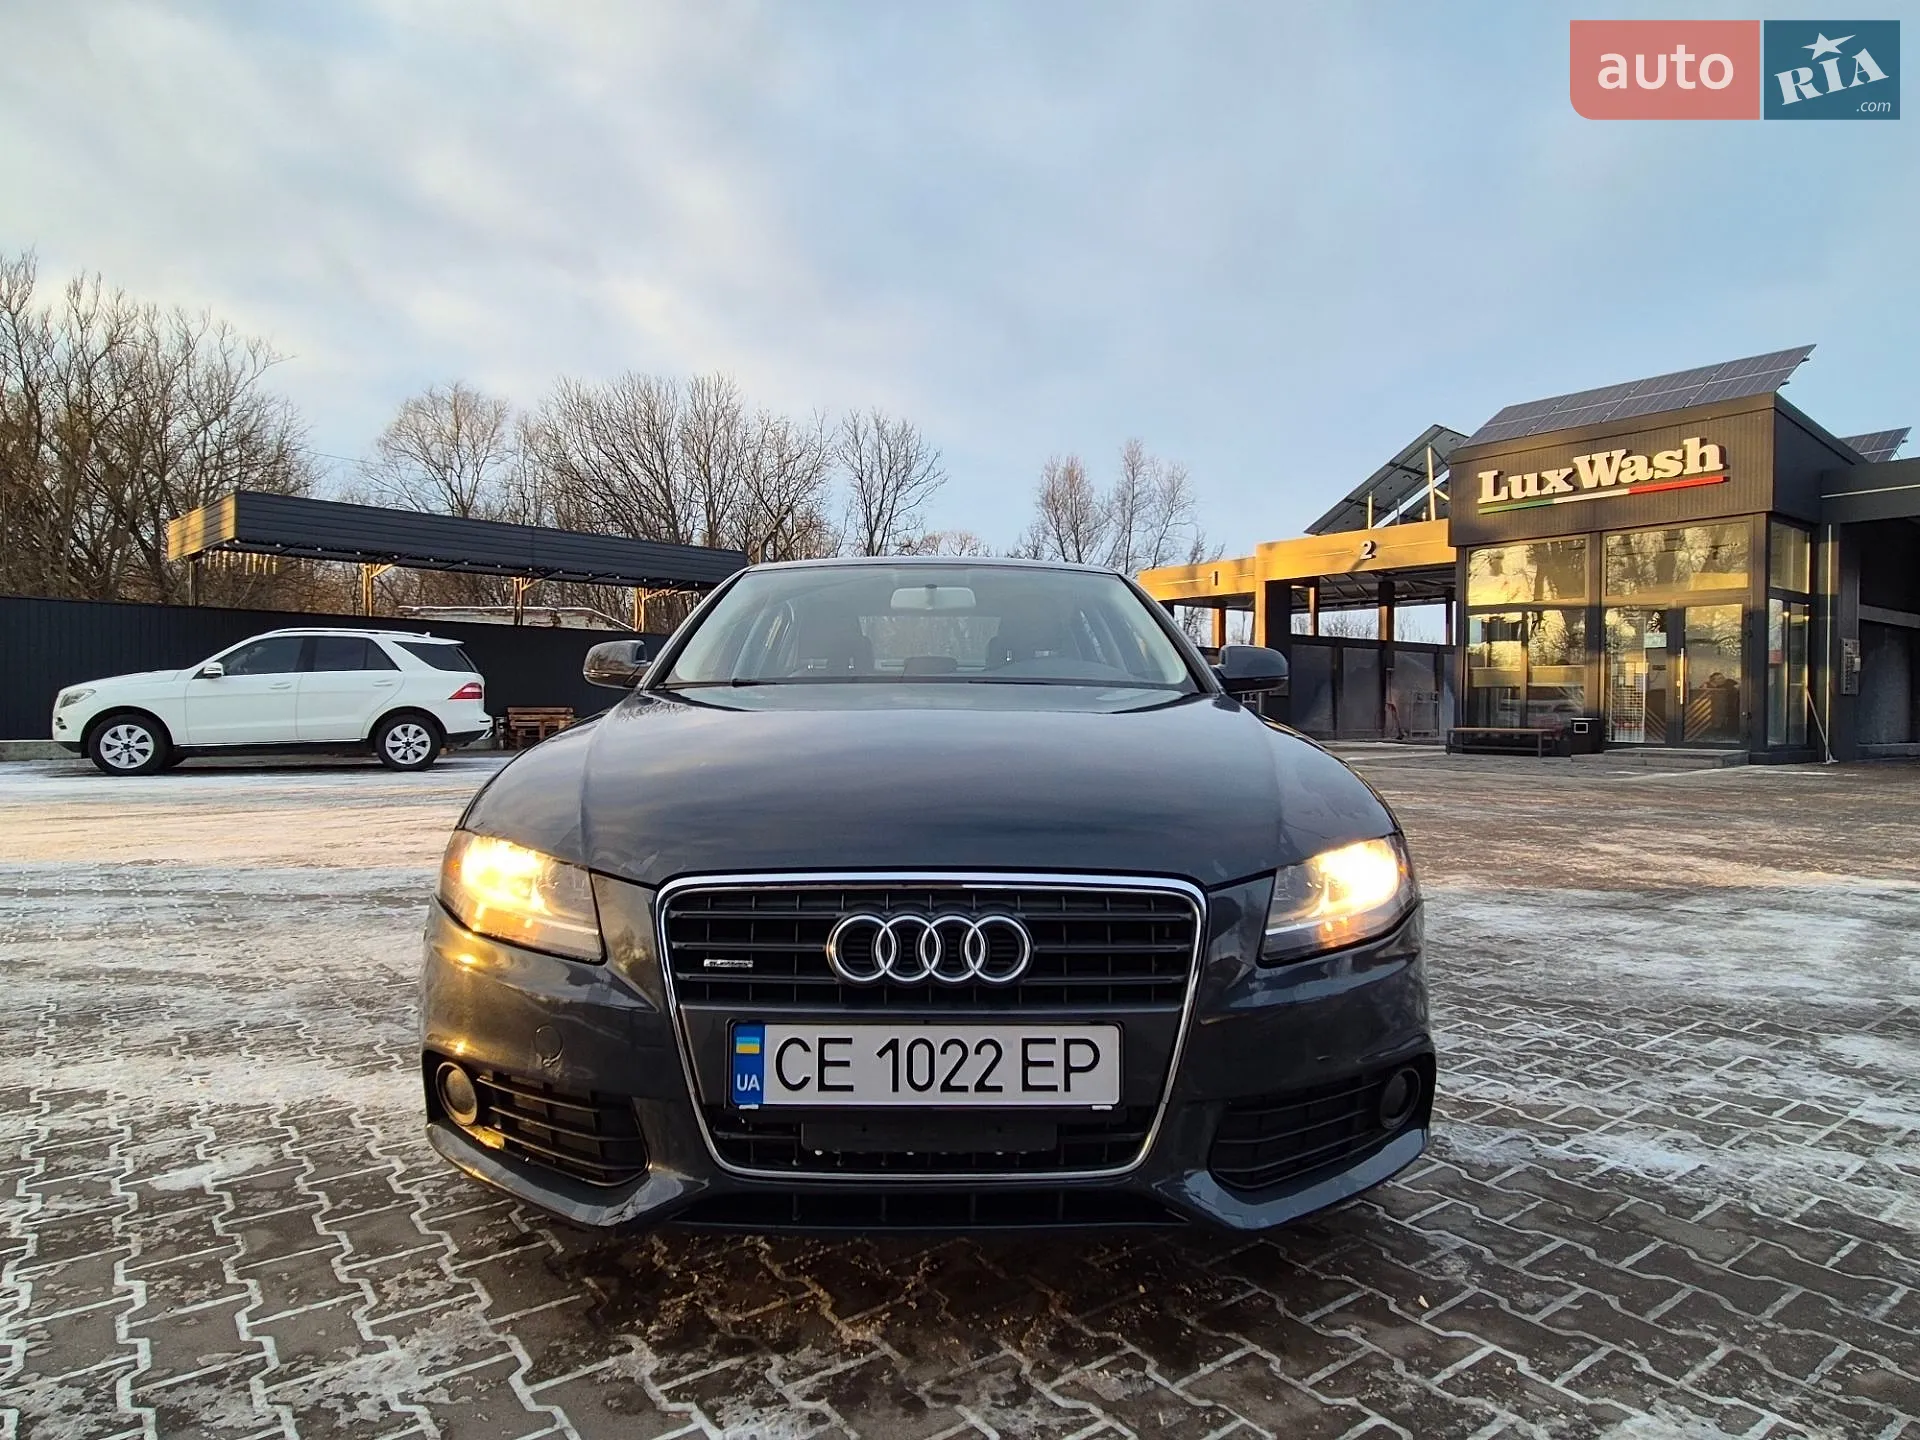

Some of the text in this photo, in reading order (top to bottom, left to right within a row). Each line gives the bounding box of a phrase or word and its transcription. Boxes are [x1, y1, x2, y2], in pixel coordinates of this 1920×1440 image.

[1360, 540, 1376, 560] 2
[775, 1037, 1101, 1093] CE 1022 EP
[736, 1073, 760, 1092] UA
